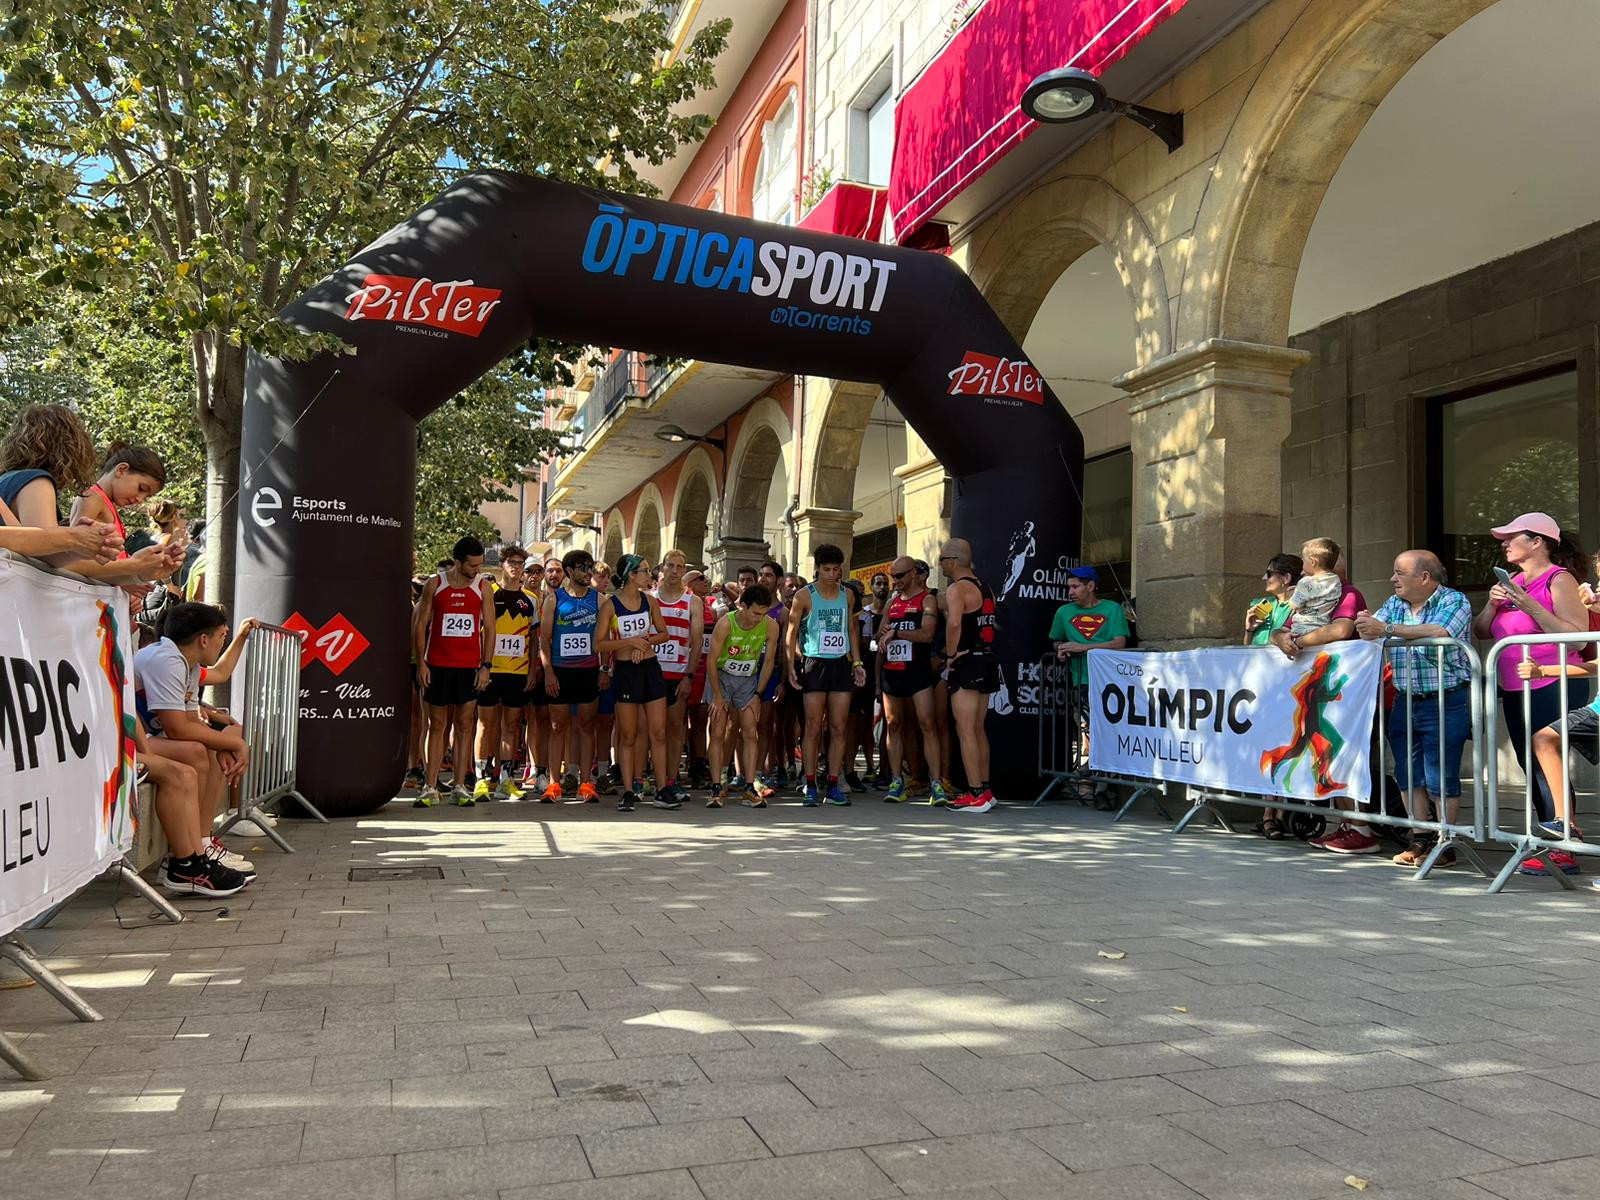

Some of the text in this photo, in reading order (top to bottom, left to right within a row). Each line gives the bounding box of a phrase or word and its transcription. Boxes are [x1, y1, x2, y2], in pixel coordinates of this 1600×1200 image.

[395, 324, 449, 339] PREMIUM LAGER
[293, 496, 347, 511] Esports
[291, 509, 402, 529] Ajuntament de Manlleu
[446, 617, 472, 631] 249
[623, 618, 646, 632] 519
[899, 620, 916, 630] ETB
[500, 638, 520, 650] 114
[563, 637, 587, 650] 535
[823, 635, 844, 647] 520
[889, 644, 907, 656] 201
[728, 661, 751, 673] 518
[1116, 663, 1144, 677] CLUB
[334, 682, 372, 700] Vila
[1101, 676, 1257, 735] OLÍMPIC
[332, 707, 344, 719] A
[1117, 734, 1204, 765] MANLLEU
